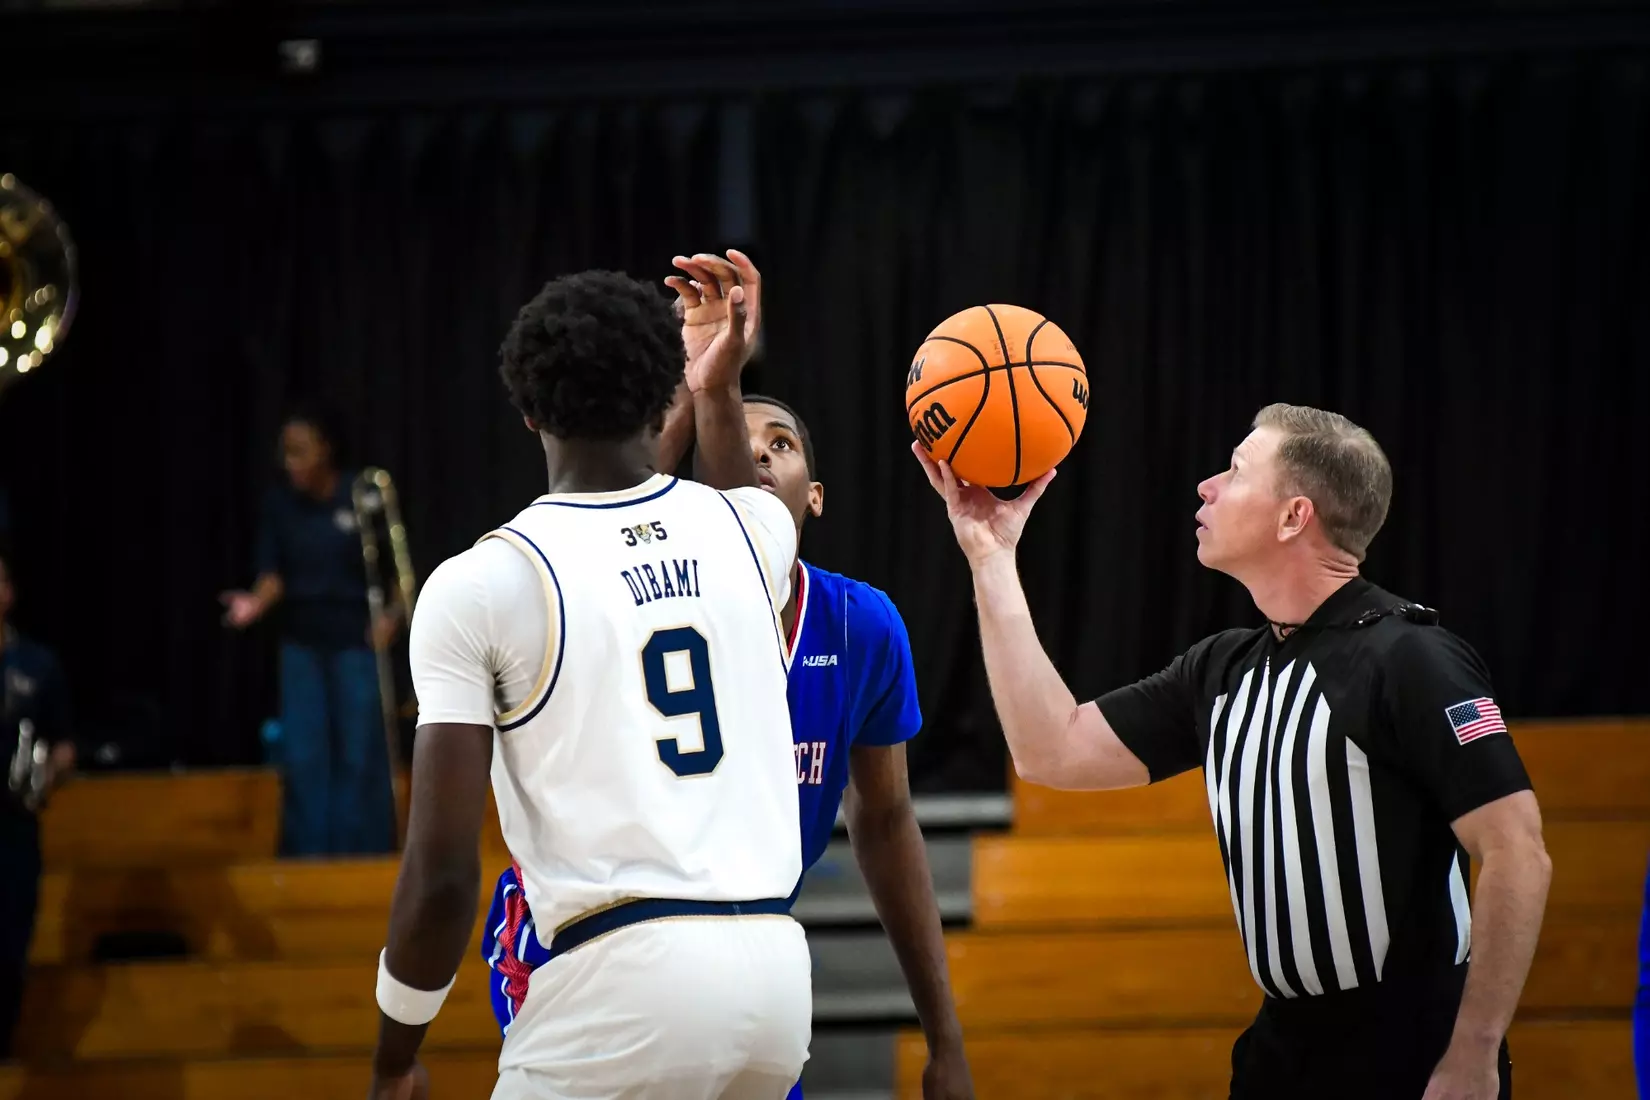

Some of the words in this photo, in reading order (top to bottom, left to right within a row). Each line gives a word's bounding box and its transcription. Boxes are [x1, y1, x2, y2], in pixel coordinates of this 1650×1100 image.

[620, 559, 701, 606] DIBAMI
[638, 623, 726, 780] 9
[794, 741, 826, 785] CH
